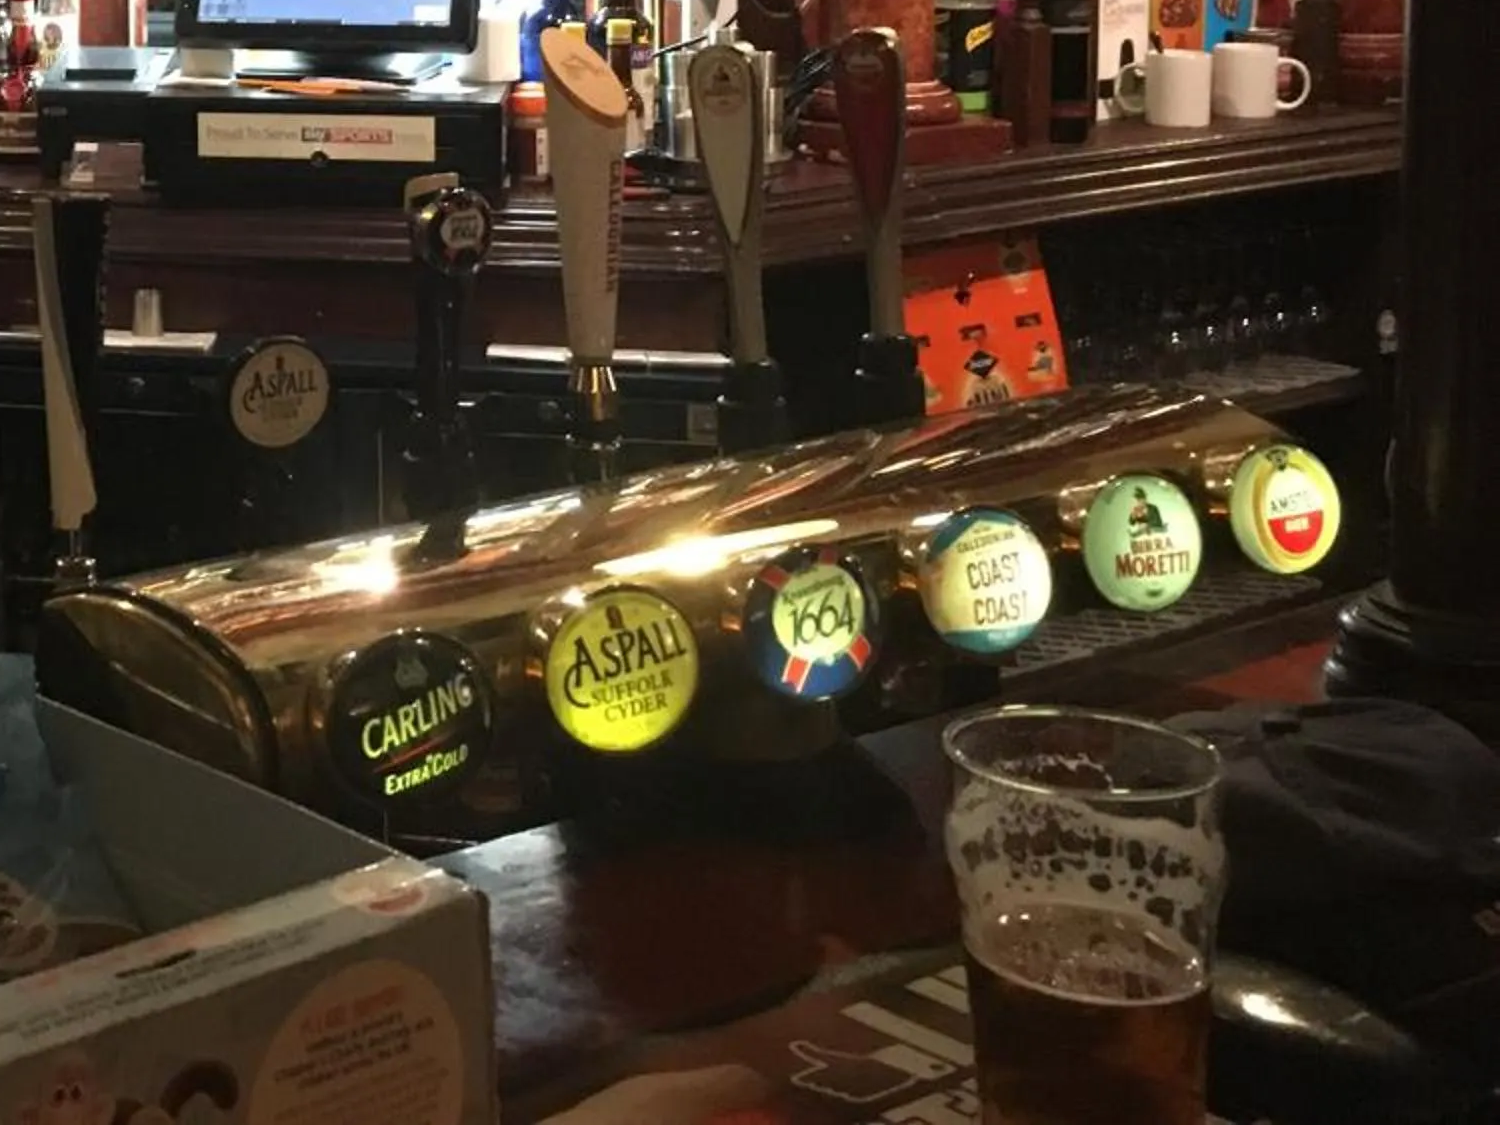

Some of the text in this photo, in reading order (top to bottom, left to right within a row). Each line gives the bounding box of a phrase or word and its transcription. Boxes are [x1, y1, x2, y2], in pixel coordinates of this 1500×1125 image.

[243, 369, 318, 413] ASPALL
[966, 552, 1020, 590] COAST
[1115, 550, 1190, 579] MORETTI
[787, 588, 857, 647] 1664
[973, 590, 1028, 626] COAST
[563, 615, 688, 708] ASPALL
[590, 668, 675, 708] SUFFOLK
[604, 693, 668, 723] CYDER
[361, 672, 473, 759] CARLING
